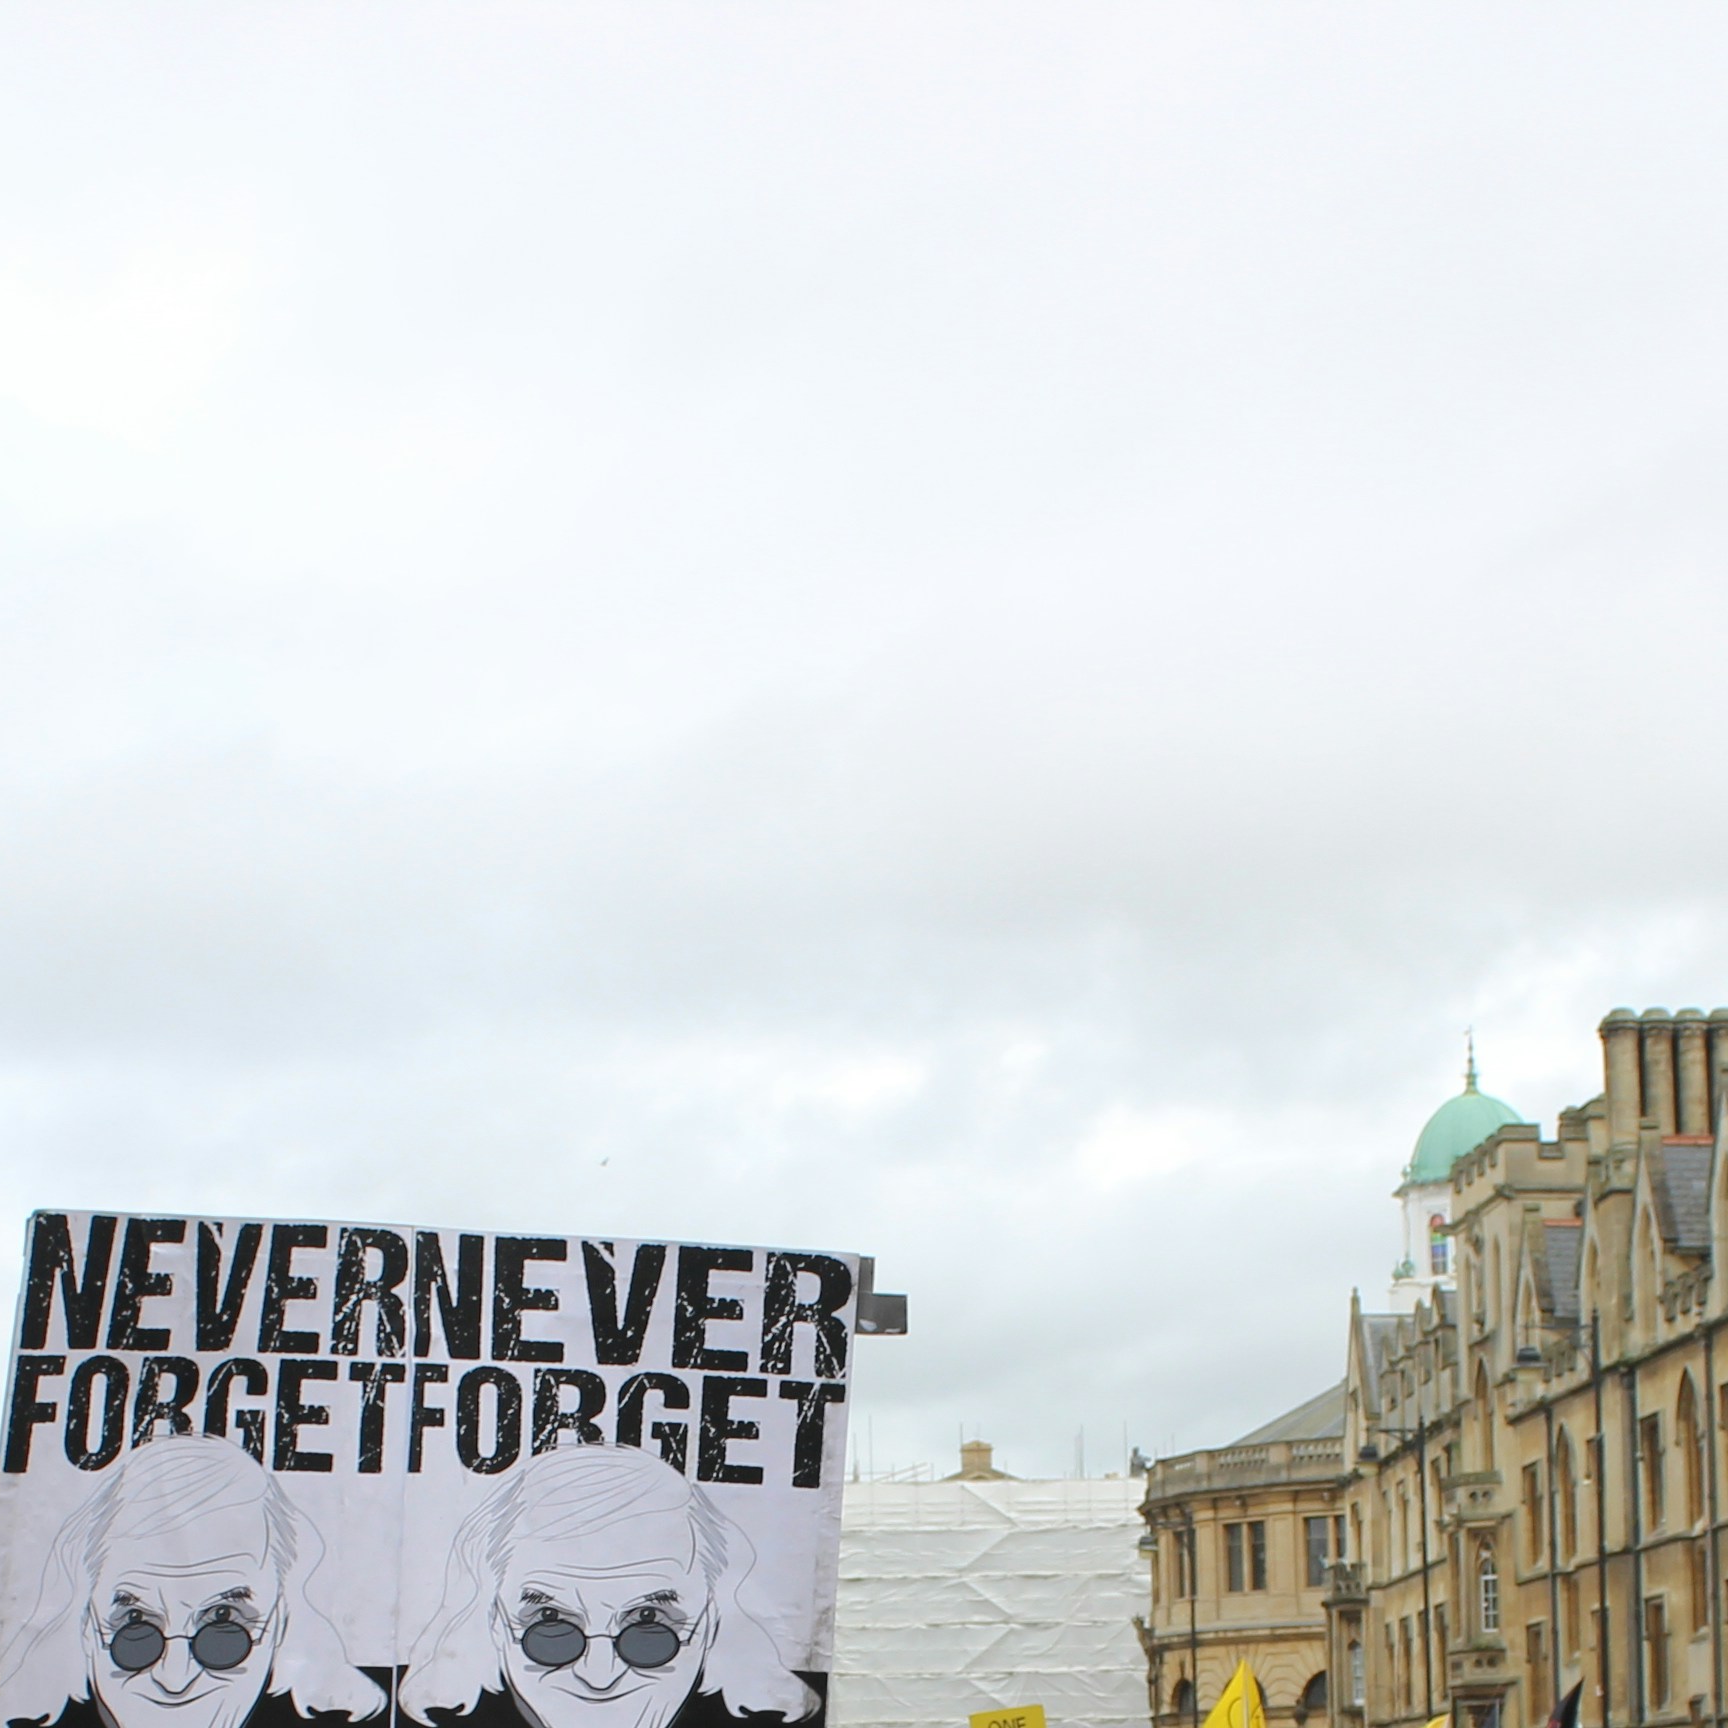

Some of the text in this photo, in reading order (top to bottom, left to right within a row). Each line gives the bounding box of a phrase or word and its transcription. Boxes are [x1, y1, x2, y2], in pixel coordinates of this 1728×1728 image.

[20, 1213, 853, 1379] NEVER NEVER
[4, 1353, 845, 1489] FORGET FORGET
